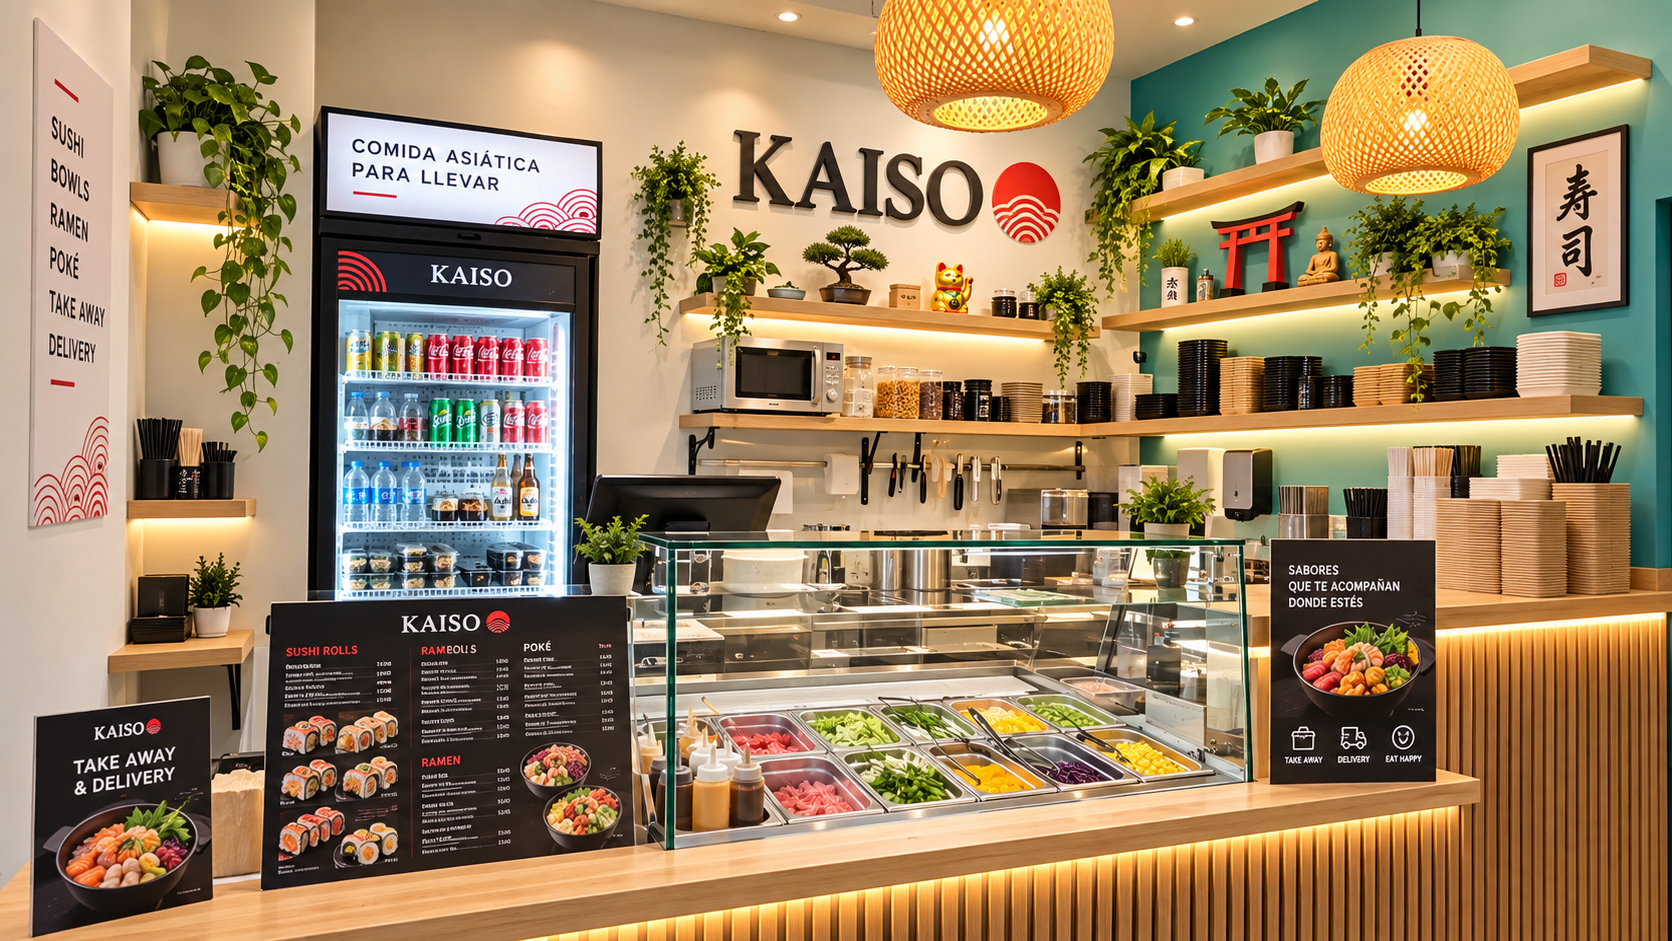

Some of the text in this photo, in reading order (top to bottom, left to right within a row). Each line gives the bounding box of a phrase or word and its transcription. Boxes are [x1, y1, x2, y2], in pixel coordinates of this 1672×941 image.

[51, 116, 84, 158] SUSHI
[352, 138, 540, 173] COMIDA ASIÁTICA
[51, 158, 89, 202] BOWLS
[352, 162, 500, 191] PARA LLEVAR
[733, 129, 984, 226] KAISO
[50, 202, 88, 242] RAMEN
[1556, 164, 1597, 277] 寿司
[50, 246, 79, 280] POKÉ
[430, 264, 513, 288] KAISO
[49, 290, 105, 327] TAKE AWAY
[49, 333, 96, 363] DELIVERY
[1288, 564, 1339, 576] SABORES
[1288, 581, 1312, 593] QUE
[1314, 581, 1328, 592] TE
[1288, 595, 1364, 608] DONDE ESTÉS
[401, 614, 481, 634] KAISO
[286, 645, 358, 657] SUSHI ROLLS
[523, 640, 552, 652] POKÉ
[94, 721, 144, 741] KAISO
[73, 747, 176, 775] TAKE AWAY
[421, 755, 461, 768] RAMEN
[1284, 756, 1302, 764] TAKE
[1337, 755, 1371, 764] DELIVERY
[1385, 755, 1423, 763] EAT HAPPY
[74, 767, 176, 796] & DELIVERY
